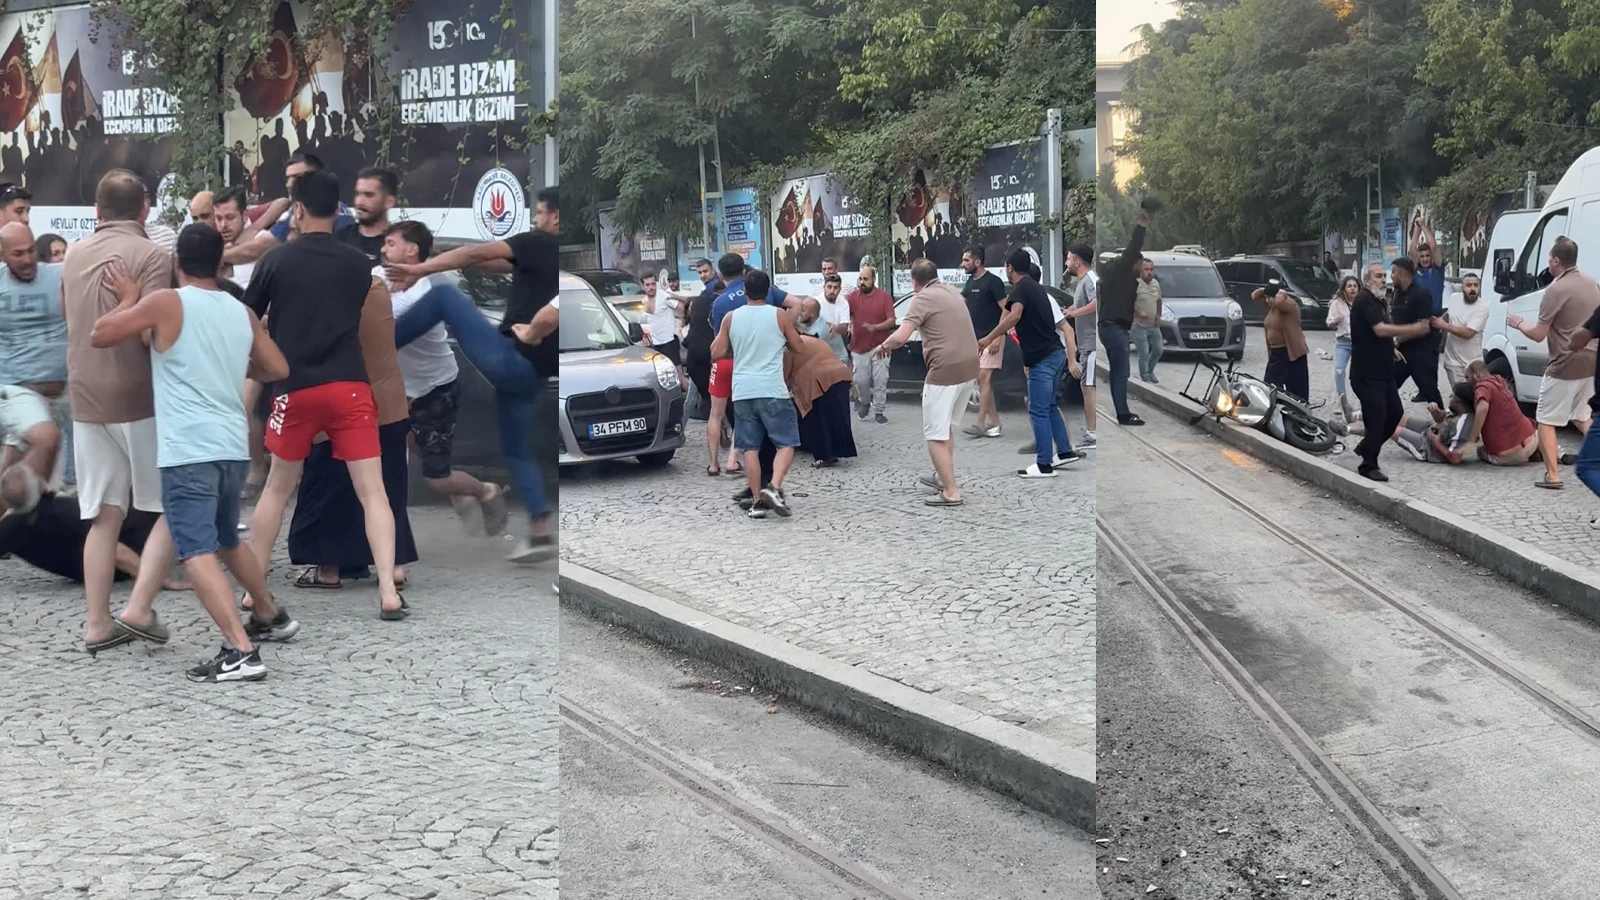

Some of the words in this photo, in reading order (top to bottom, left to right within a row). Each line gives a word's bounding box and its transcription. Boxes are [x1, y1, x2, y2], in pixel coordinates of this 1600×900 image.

[401, 65, 456, 100] İRADE
[459, 59, 516, 96] BİZİM
[142, 87, 183, 115] BİZ
[401, 98, 473, 124] EGEMENLİK
[475, 96, 516, 122] BİZİM
[977, 197, 1005, 215] İRADE
[594, 424, 606, 435] 34
[608, 420, 632, 433] PFM
[633, 418, 646, 430] 90
